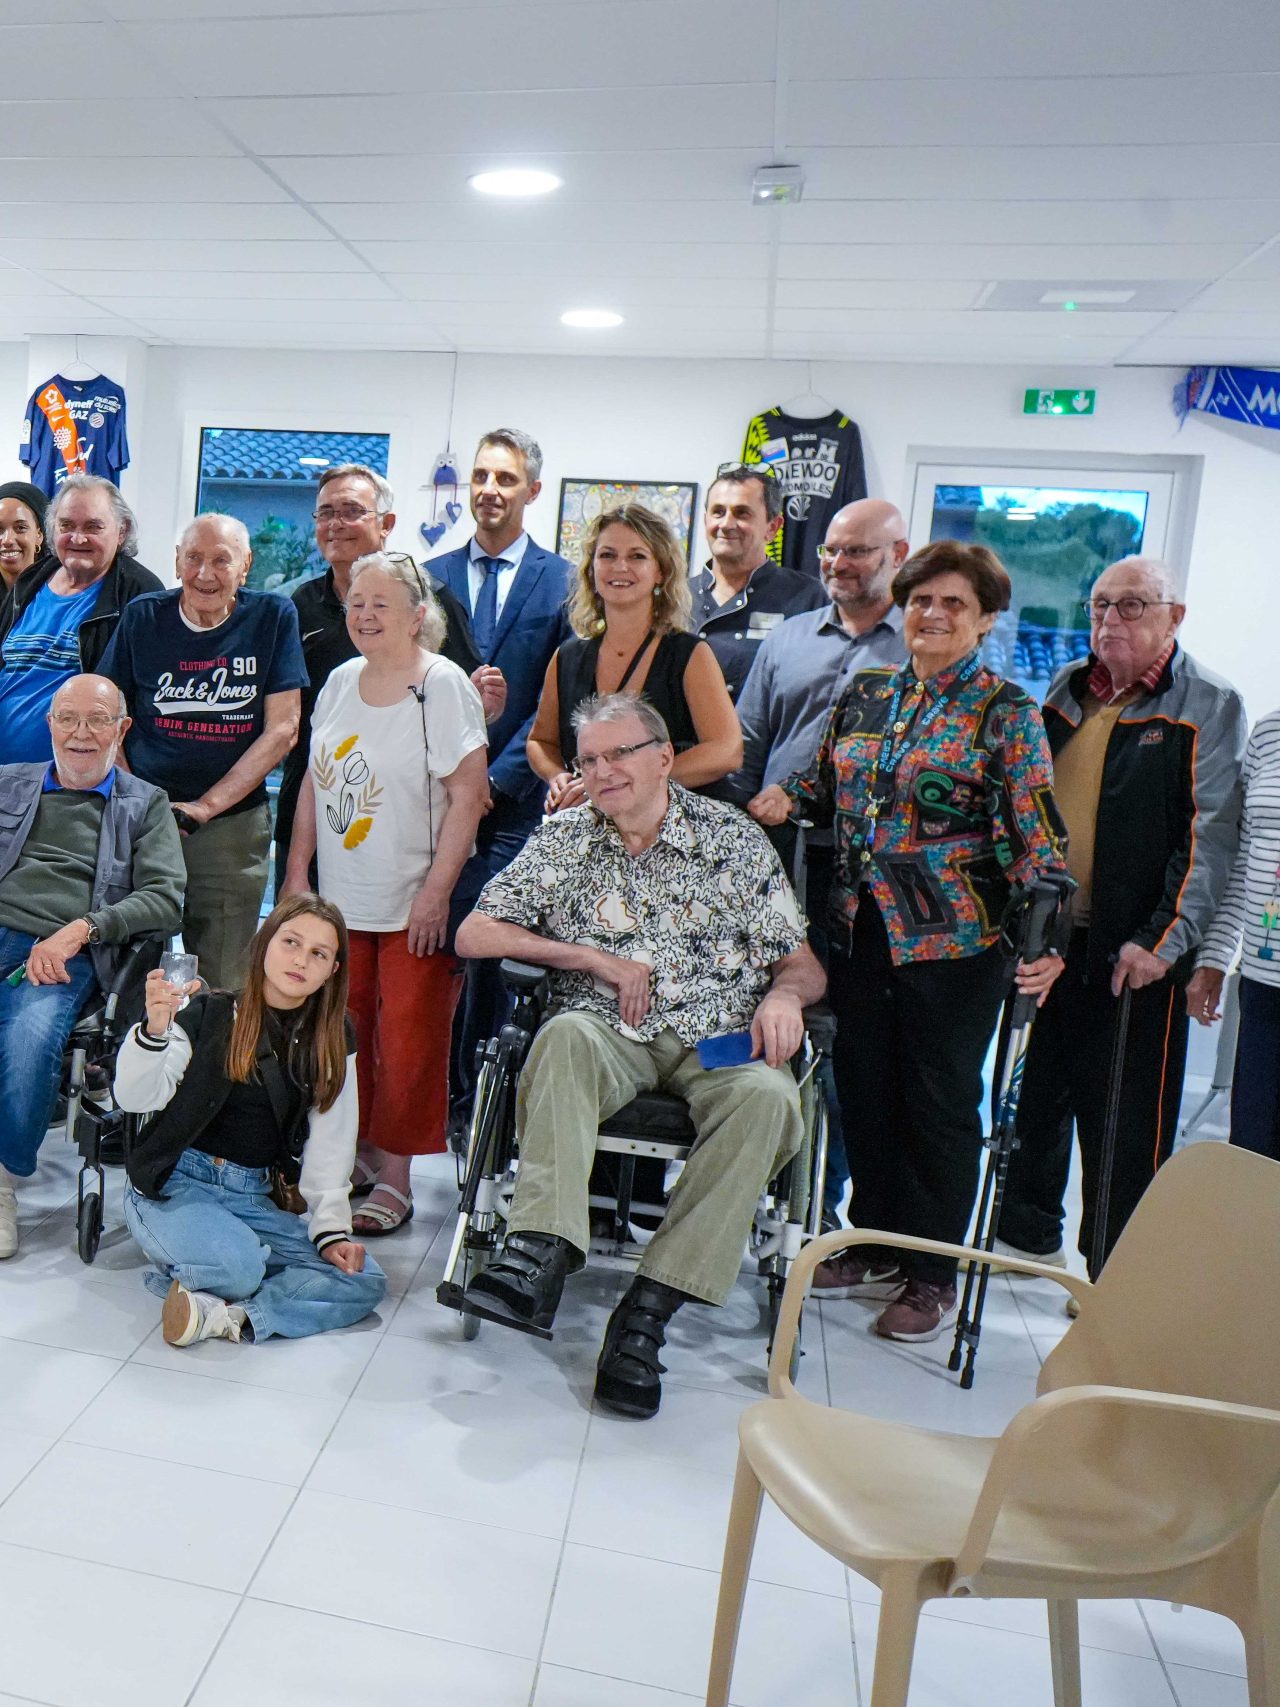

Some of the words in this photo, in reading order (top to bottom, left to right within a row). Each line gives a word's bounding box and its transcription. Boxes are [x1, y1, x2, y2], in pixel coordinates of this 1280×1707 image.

[64, 400, 94, 410] dyneff
[1246, 383, 1280, 416] M
[69, 410, 89, 420] GAZ
[775, 462, 836, 480] DEWOO
[233, 656, 257, 676] 90
[188, 721, 252, 734] GENERATION
